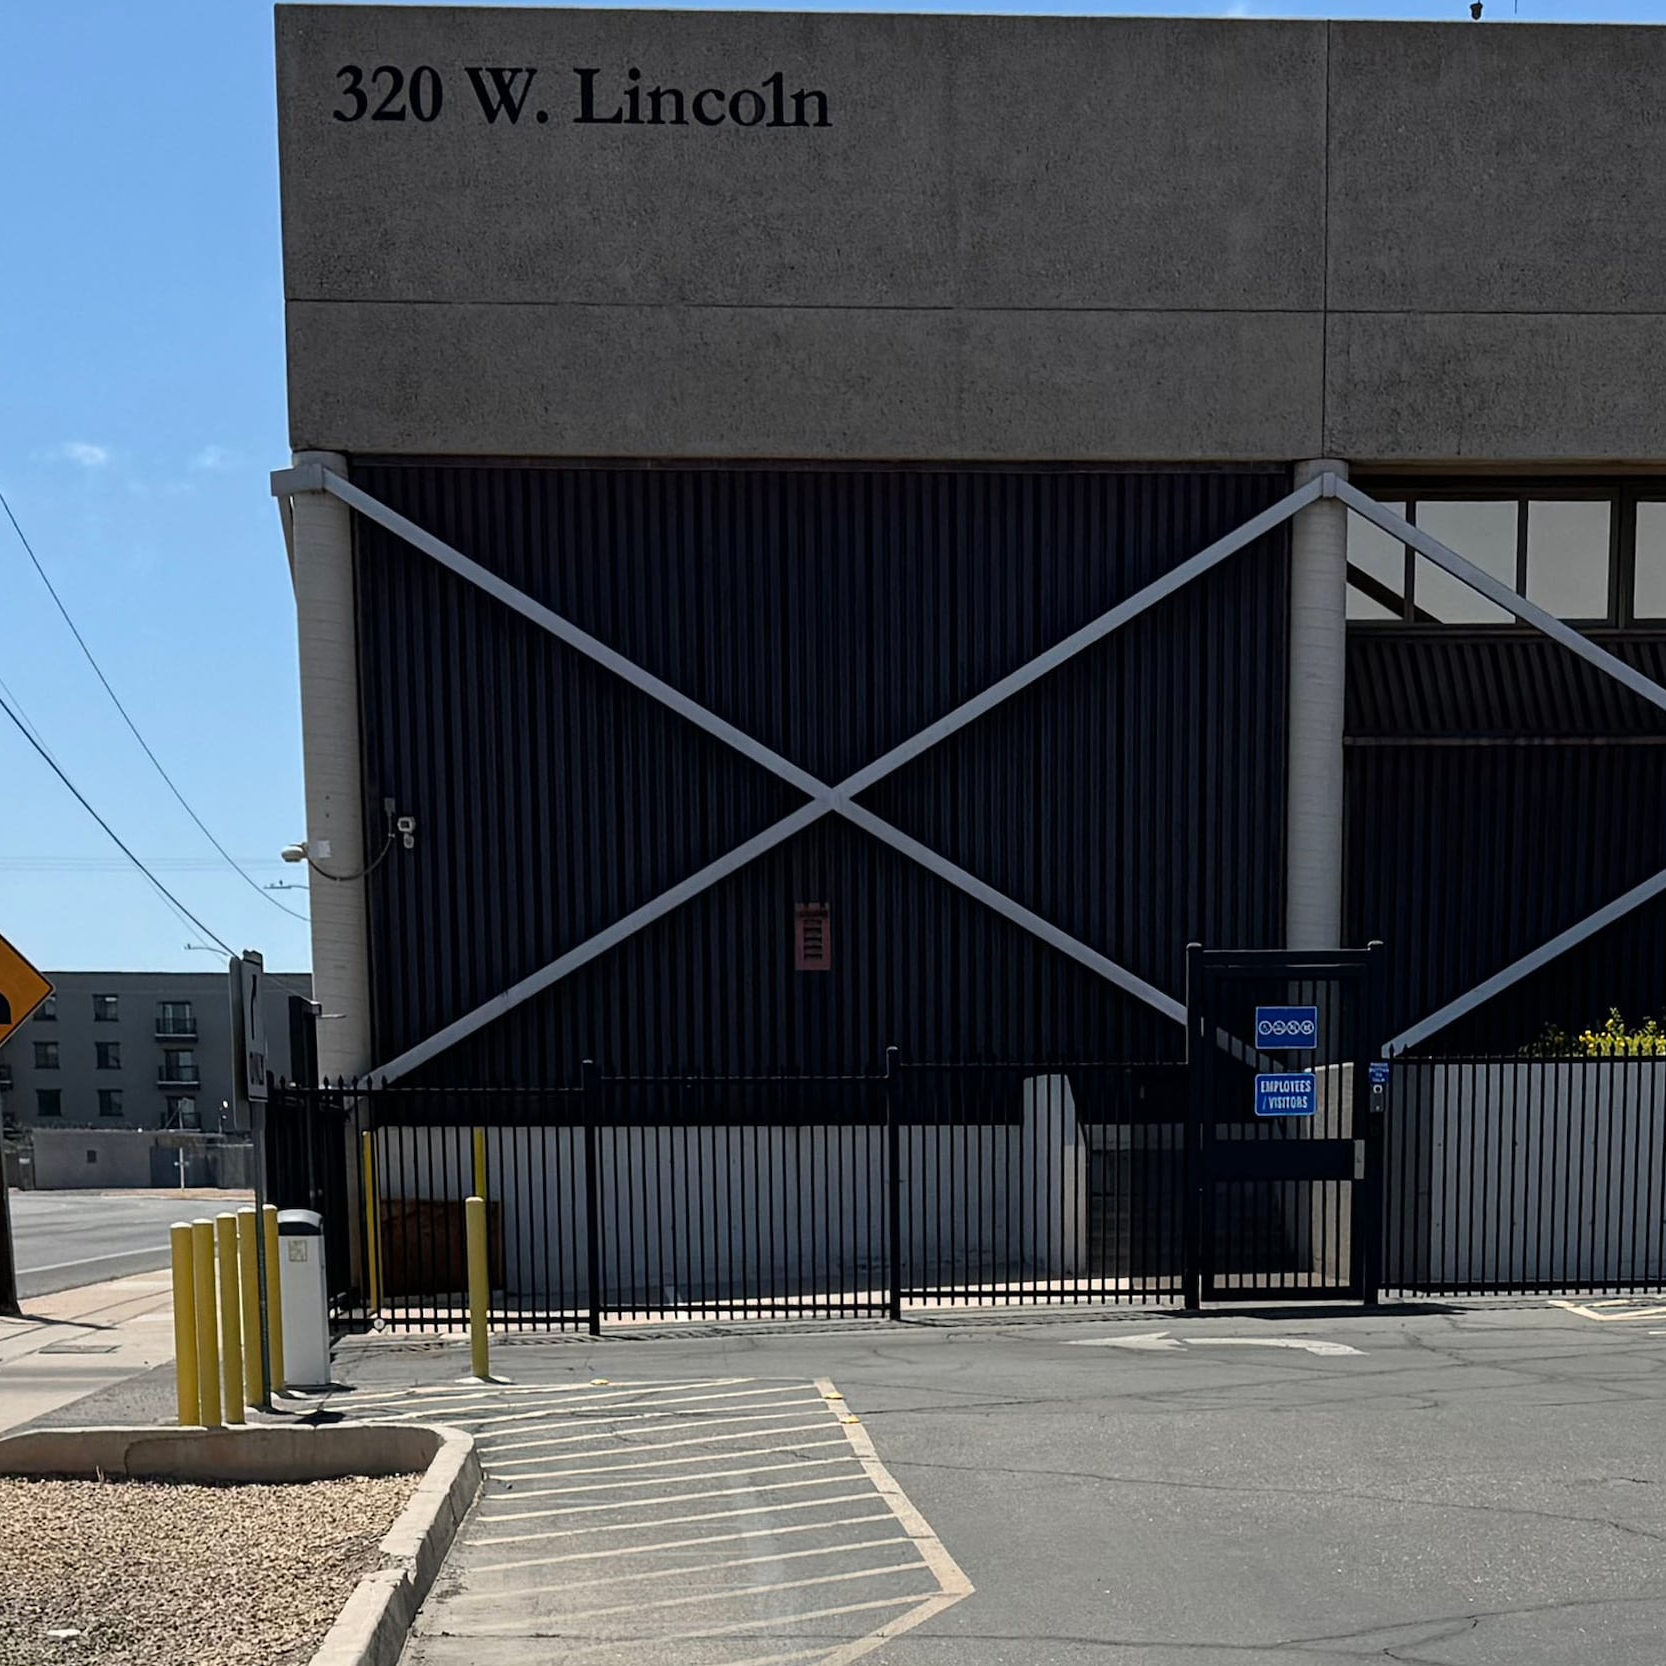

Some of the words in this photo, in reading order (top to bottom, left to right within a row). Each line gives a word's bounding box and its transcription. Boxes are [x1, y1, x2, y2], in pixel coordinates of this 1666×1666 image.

[332, 64, 444, 123] 320
[464, 66, 549, 125] W.
[572, 67, 833, 128] Lincoln
[1260, 1079, 1312, 1093] EMPLOYEES
